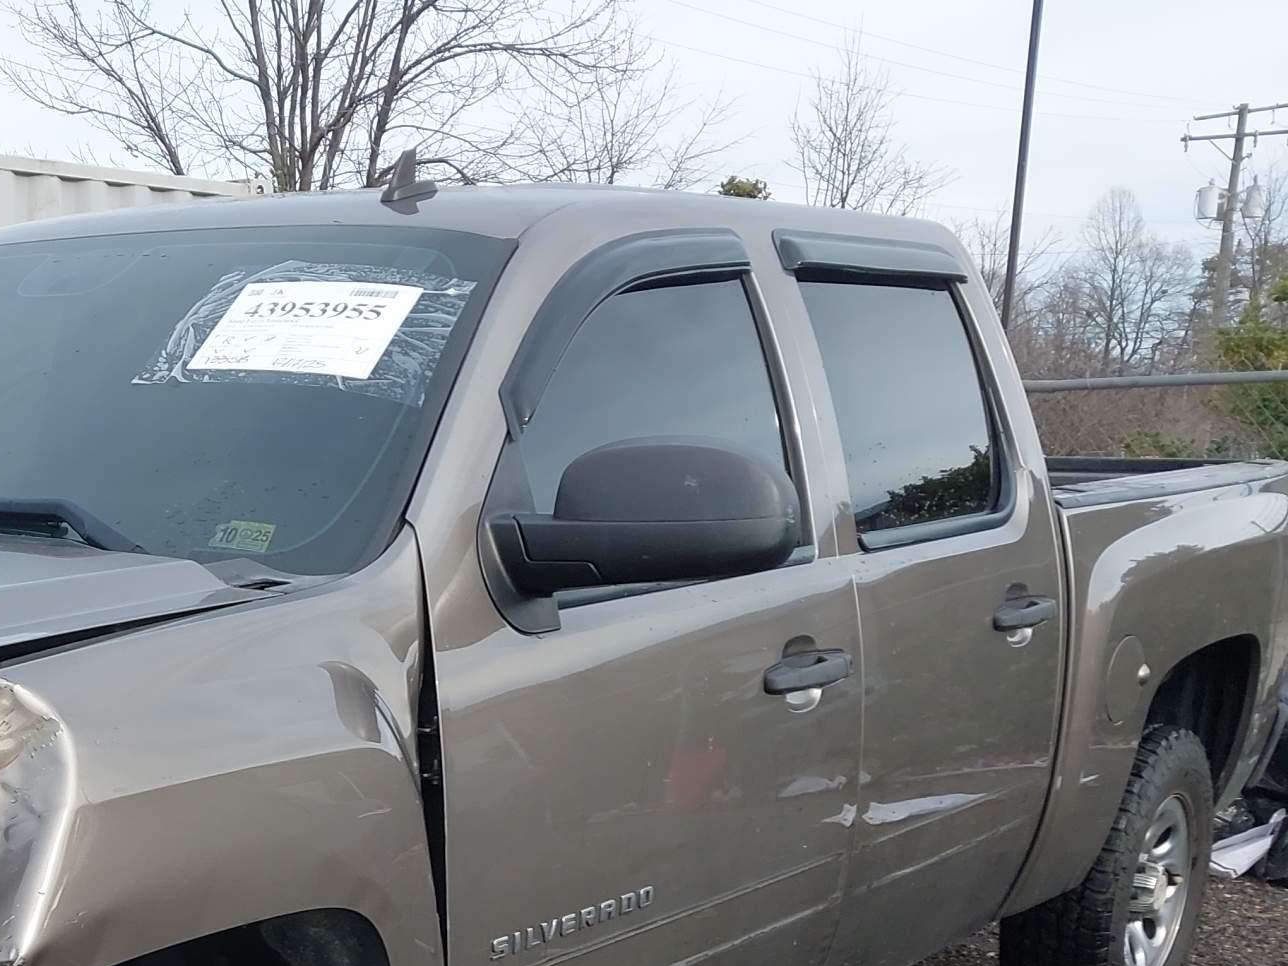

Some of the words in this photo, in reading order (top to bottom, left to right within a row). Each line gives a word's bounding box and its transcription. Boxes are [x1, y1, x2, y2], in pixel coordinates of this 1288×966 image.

[244, 301, 387, 320] 43953955
[218, 526, 239, 543] 10
[251, 529, 272, 543] 25
[489, 886, 654, 961] SILVERADO
